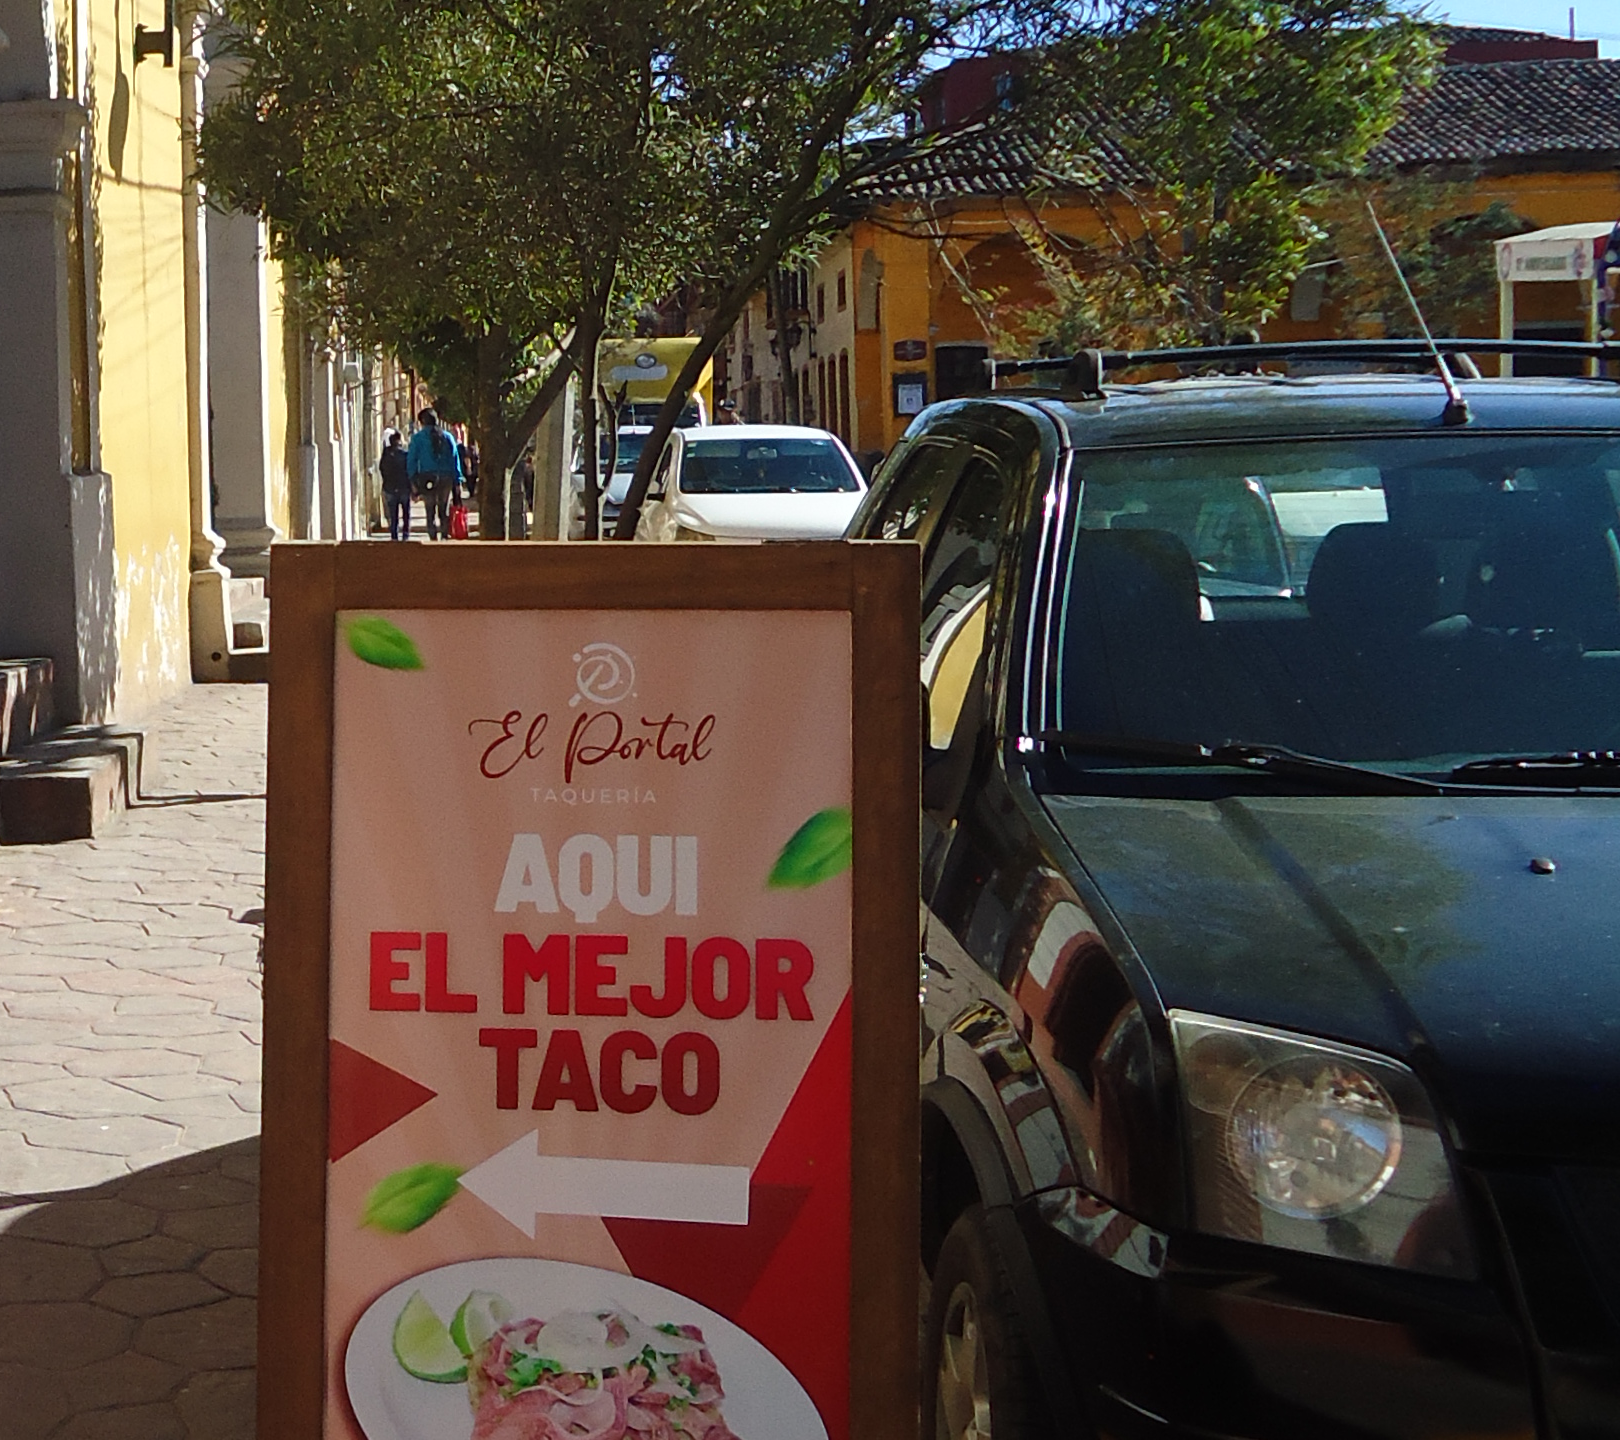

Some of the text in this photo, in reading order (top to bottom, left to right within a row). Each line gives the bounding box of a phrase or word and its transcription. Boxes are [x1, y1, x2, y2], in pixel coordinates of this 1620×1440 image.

[468, 710, 716, 784] El Portal
[531, 786, 657, 806] TAQUERÍA
[494, 833, 698, 923] AQUI
[369, 931, 815, 1021] EL MEJOR
[479, 1028, 721, 1116] TACO
